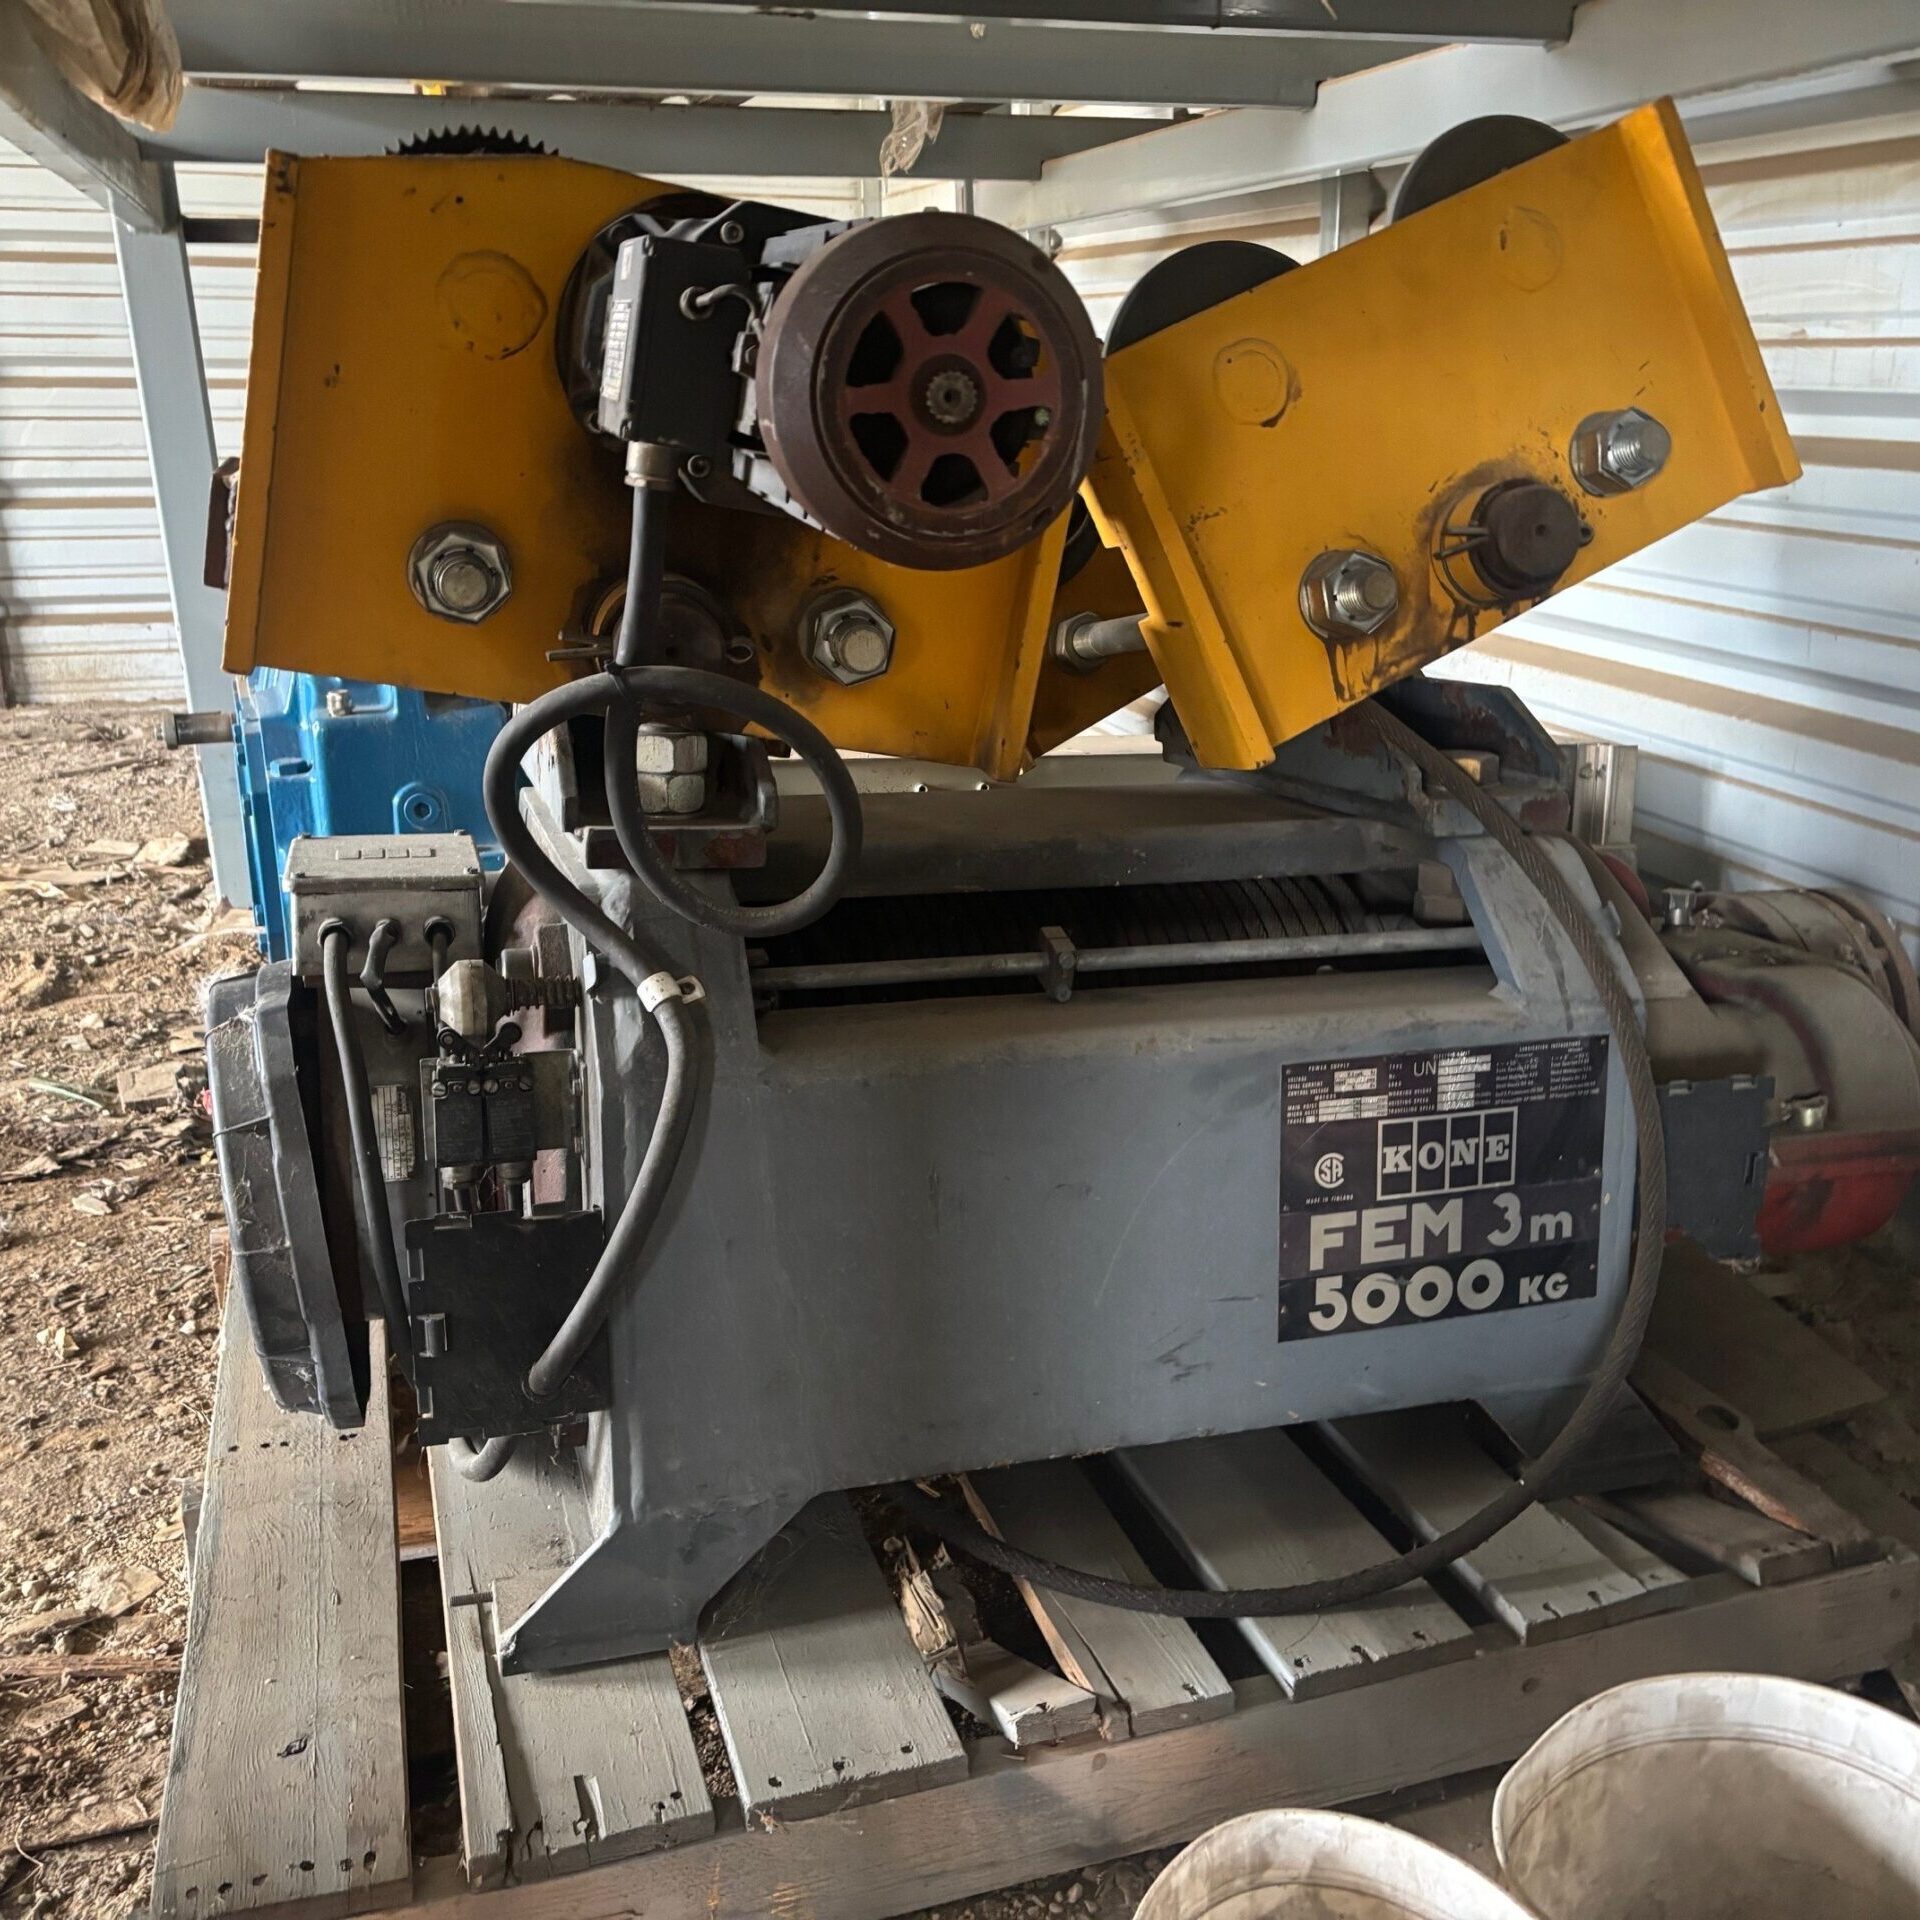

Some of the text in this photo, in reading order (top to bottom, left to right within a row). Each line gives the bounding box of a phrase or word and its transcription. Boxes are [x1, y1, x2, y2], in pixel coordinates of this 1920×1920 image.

[1382, 1133, 1510, 1175] KONE
[1309, 1192, 1573, 1272] FEM 3 m
[1308, 1258, 1569, 1332] 5000 KG
